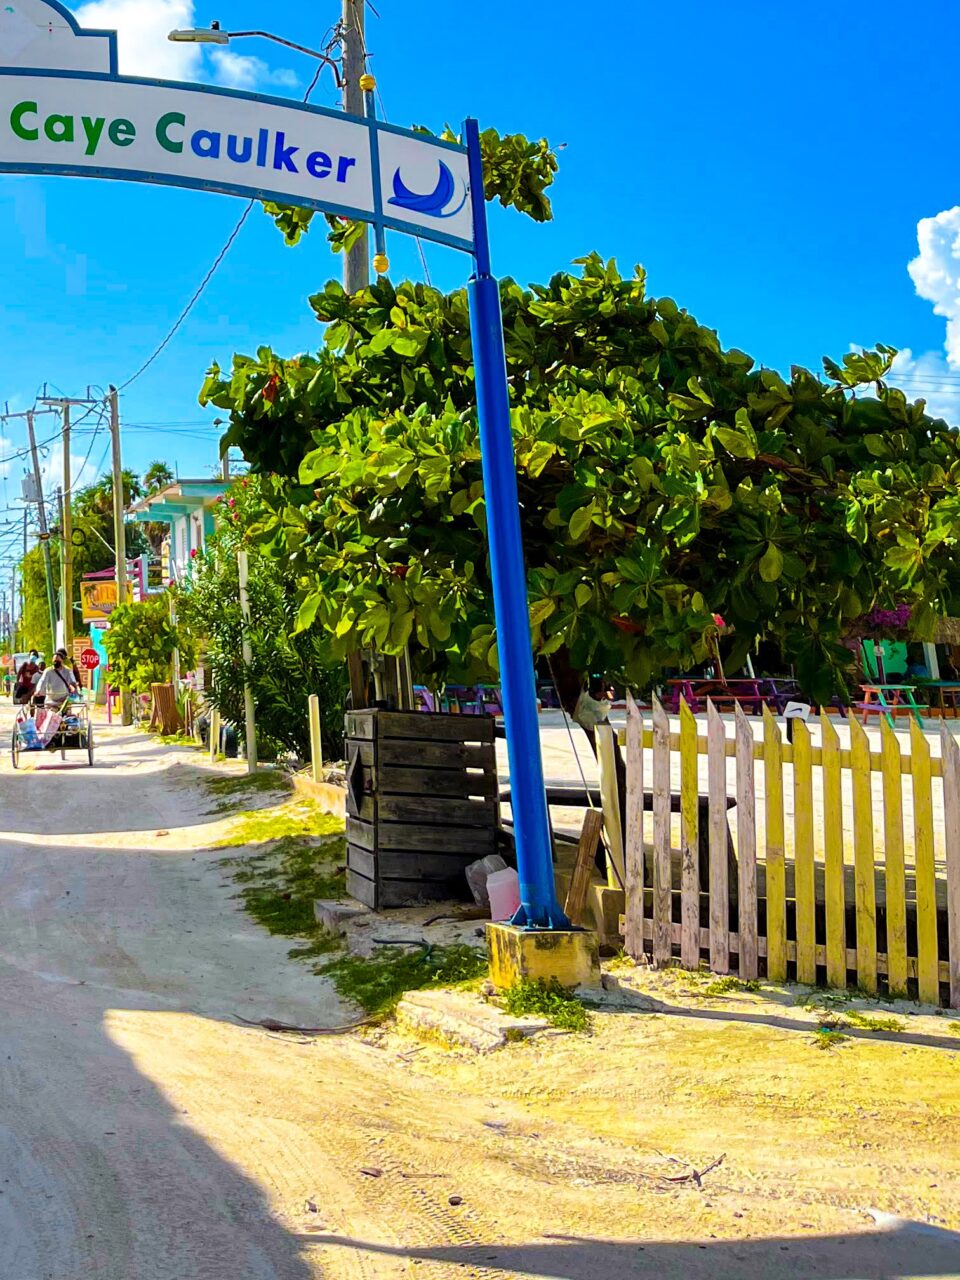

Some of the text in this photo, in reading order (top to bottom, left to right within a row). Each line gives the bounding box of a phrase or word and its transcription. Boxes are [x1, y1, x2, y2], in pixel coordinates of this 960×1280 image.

[10, 101, 136, 156] Caye
[156, 111, 357, 183] Caulker
[81, 654, 99, 664] STOP
